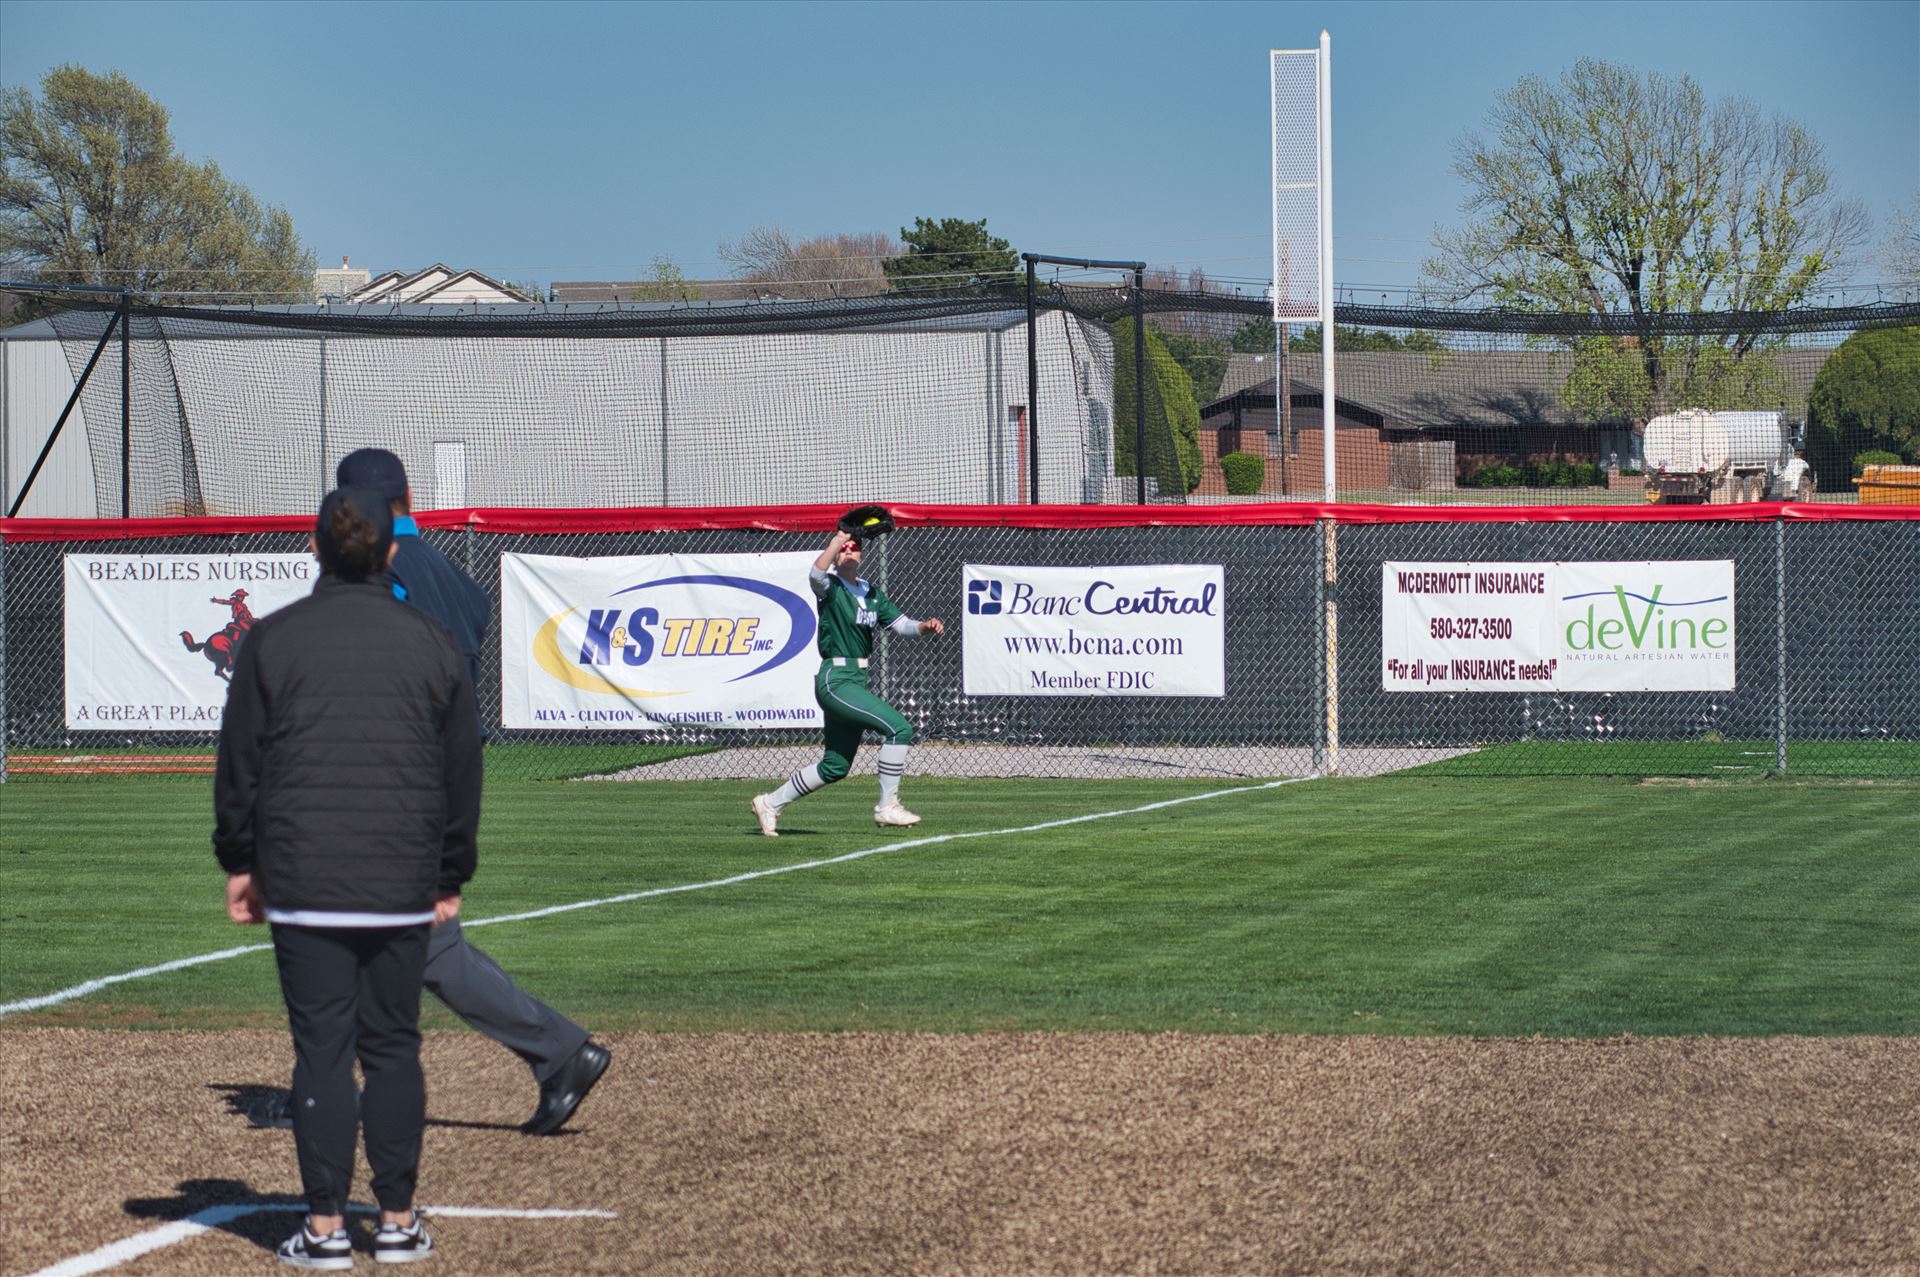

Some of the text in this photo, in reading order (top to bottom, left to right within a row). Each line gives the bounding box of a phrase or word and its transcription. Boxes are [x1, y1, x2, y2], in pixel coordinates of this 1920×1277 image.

[88, 561, 309, 581] BEADLES NURSING
[1398, 572, 1545, 594] MCDERMOTT INSURANCE
[1430, 617, 1513, 640] 580-327-3500
[1566, 584, 1728, 651] deVine
[579, 606, 774, 667] K&S TIRE INC.
[1004, 629, 1184, 656] www.bcna.com
[1566, 652, 1730, 662] NATURAL ARTESIAN WATER
[1030, 670, 1155, 689] Member FDIC
[1411, 659, 1423, 680] all
[1426, 664, 1449, 685] your
[1451, 659, 1516, 681] INSURANCE
[76, 704, 225, 721] A GREAT PLAC
[534, 709, 567, 721] ALVA
[578, 710, 634, 722] CLINTON
[646, 712, 723, 723] KINGFISHER
[735, 708, 816, 721] WOODWARD
